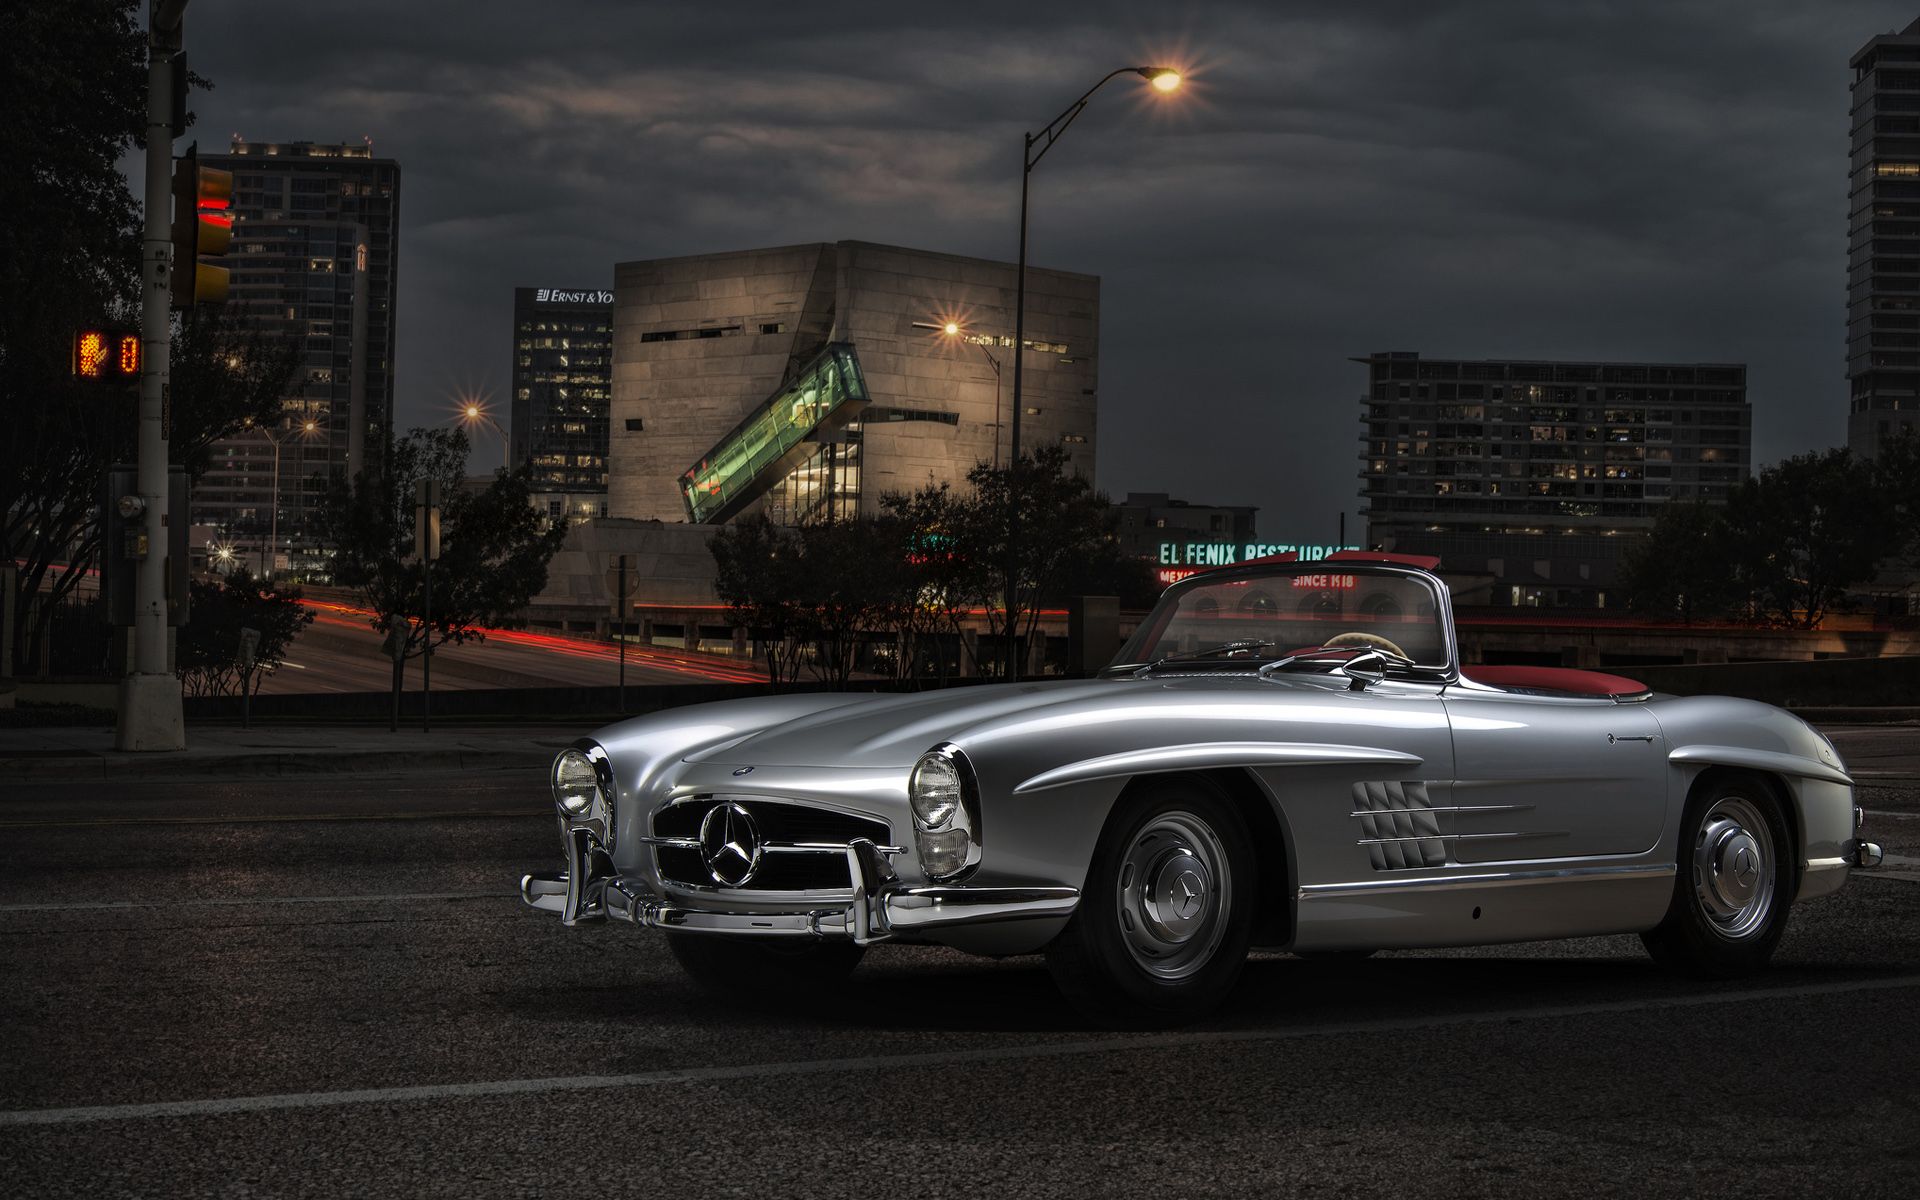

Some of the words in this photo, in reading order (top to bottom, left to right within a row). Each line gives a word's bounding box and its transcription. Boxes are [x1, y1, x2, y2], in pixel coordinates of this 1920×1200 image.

[551, 289, 586, 303] ERNST
[587, 292, 596, 303] &
[597, 290, 615, 304] YO
[1160, 543, 1179, 564] EL
[1186, 543, 1236, 565] FENIX
[1293, 575, 1326, 587] SINCE
